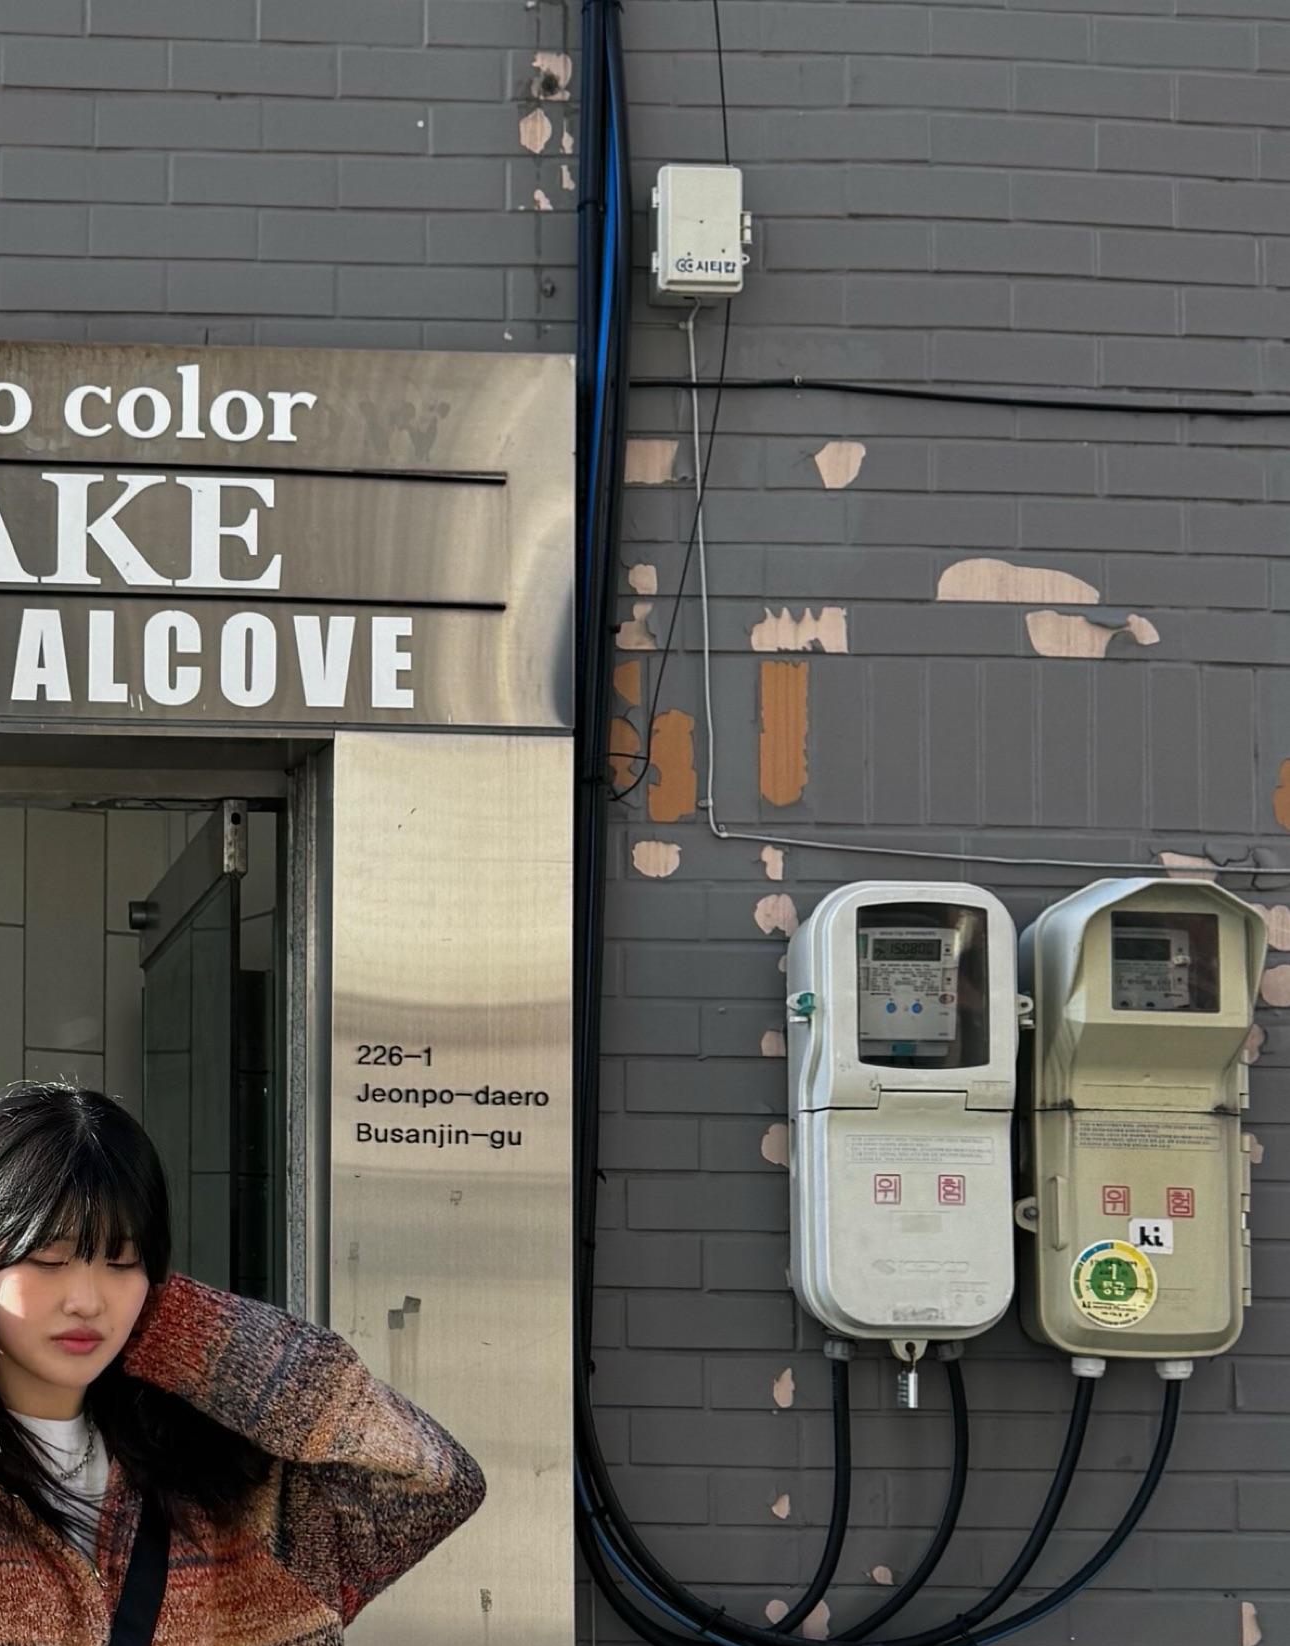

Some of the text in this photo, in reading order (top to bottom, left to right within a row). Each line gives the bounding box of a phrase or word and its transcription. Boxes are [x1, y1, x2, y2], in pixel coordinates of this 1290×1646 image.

[64, 364, 317, 442] color
[11, 608, 415, 709] ALCOVE
[357, 1045, 432, 1067] 226-1
[357, 1083, 549, 1108] Jeonpo-daero
[356, 1123, 522, 1149] Busanjin-gu
